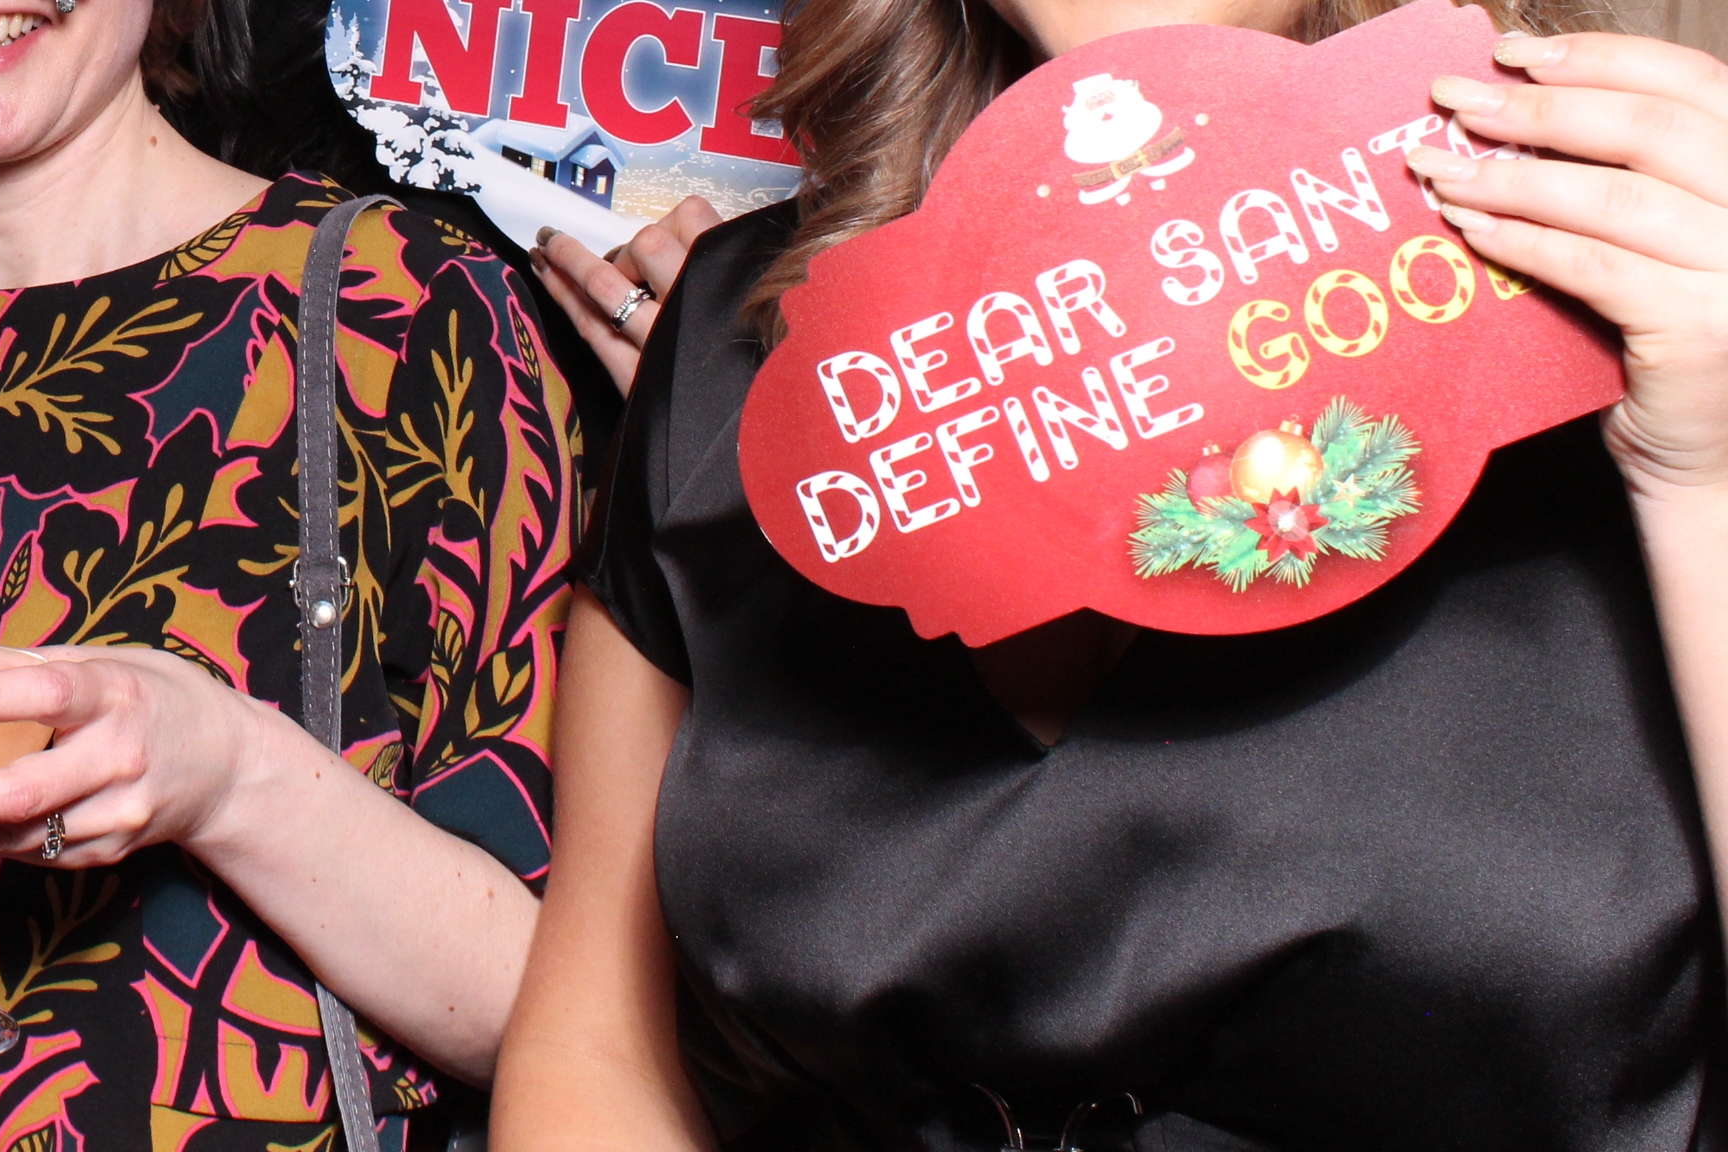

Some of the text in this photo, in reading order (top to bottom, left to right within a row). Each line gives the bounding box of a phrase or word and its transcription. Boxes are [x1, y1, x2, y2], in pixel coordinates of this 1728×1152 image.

[796, 235, 1540, 563] DEFINE GOO
[816, 111, 1538, 444] DEAR SANT
